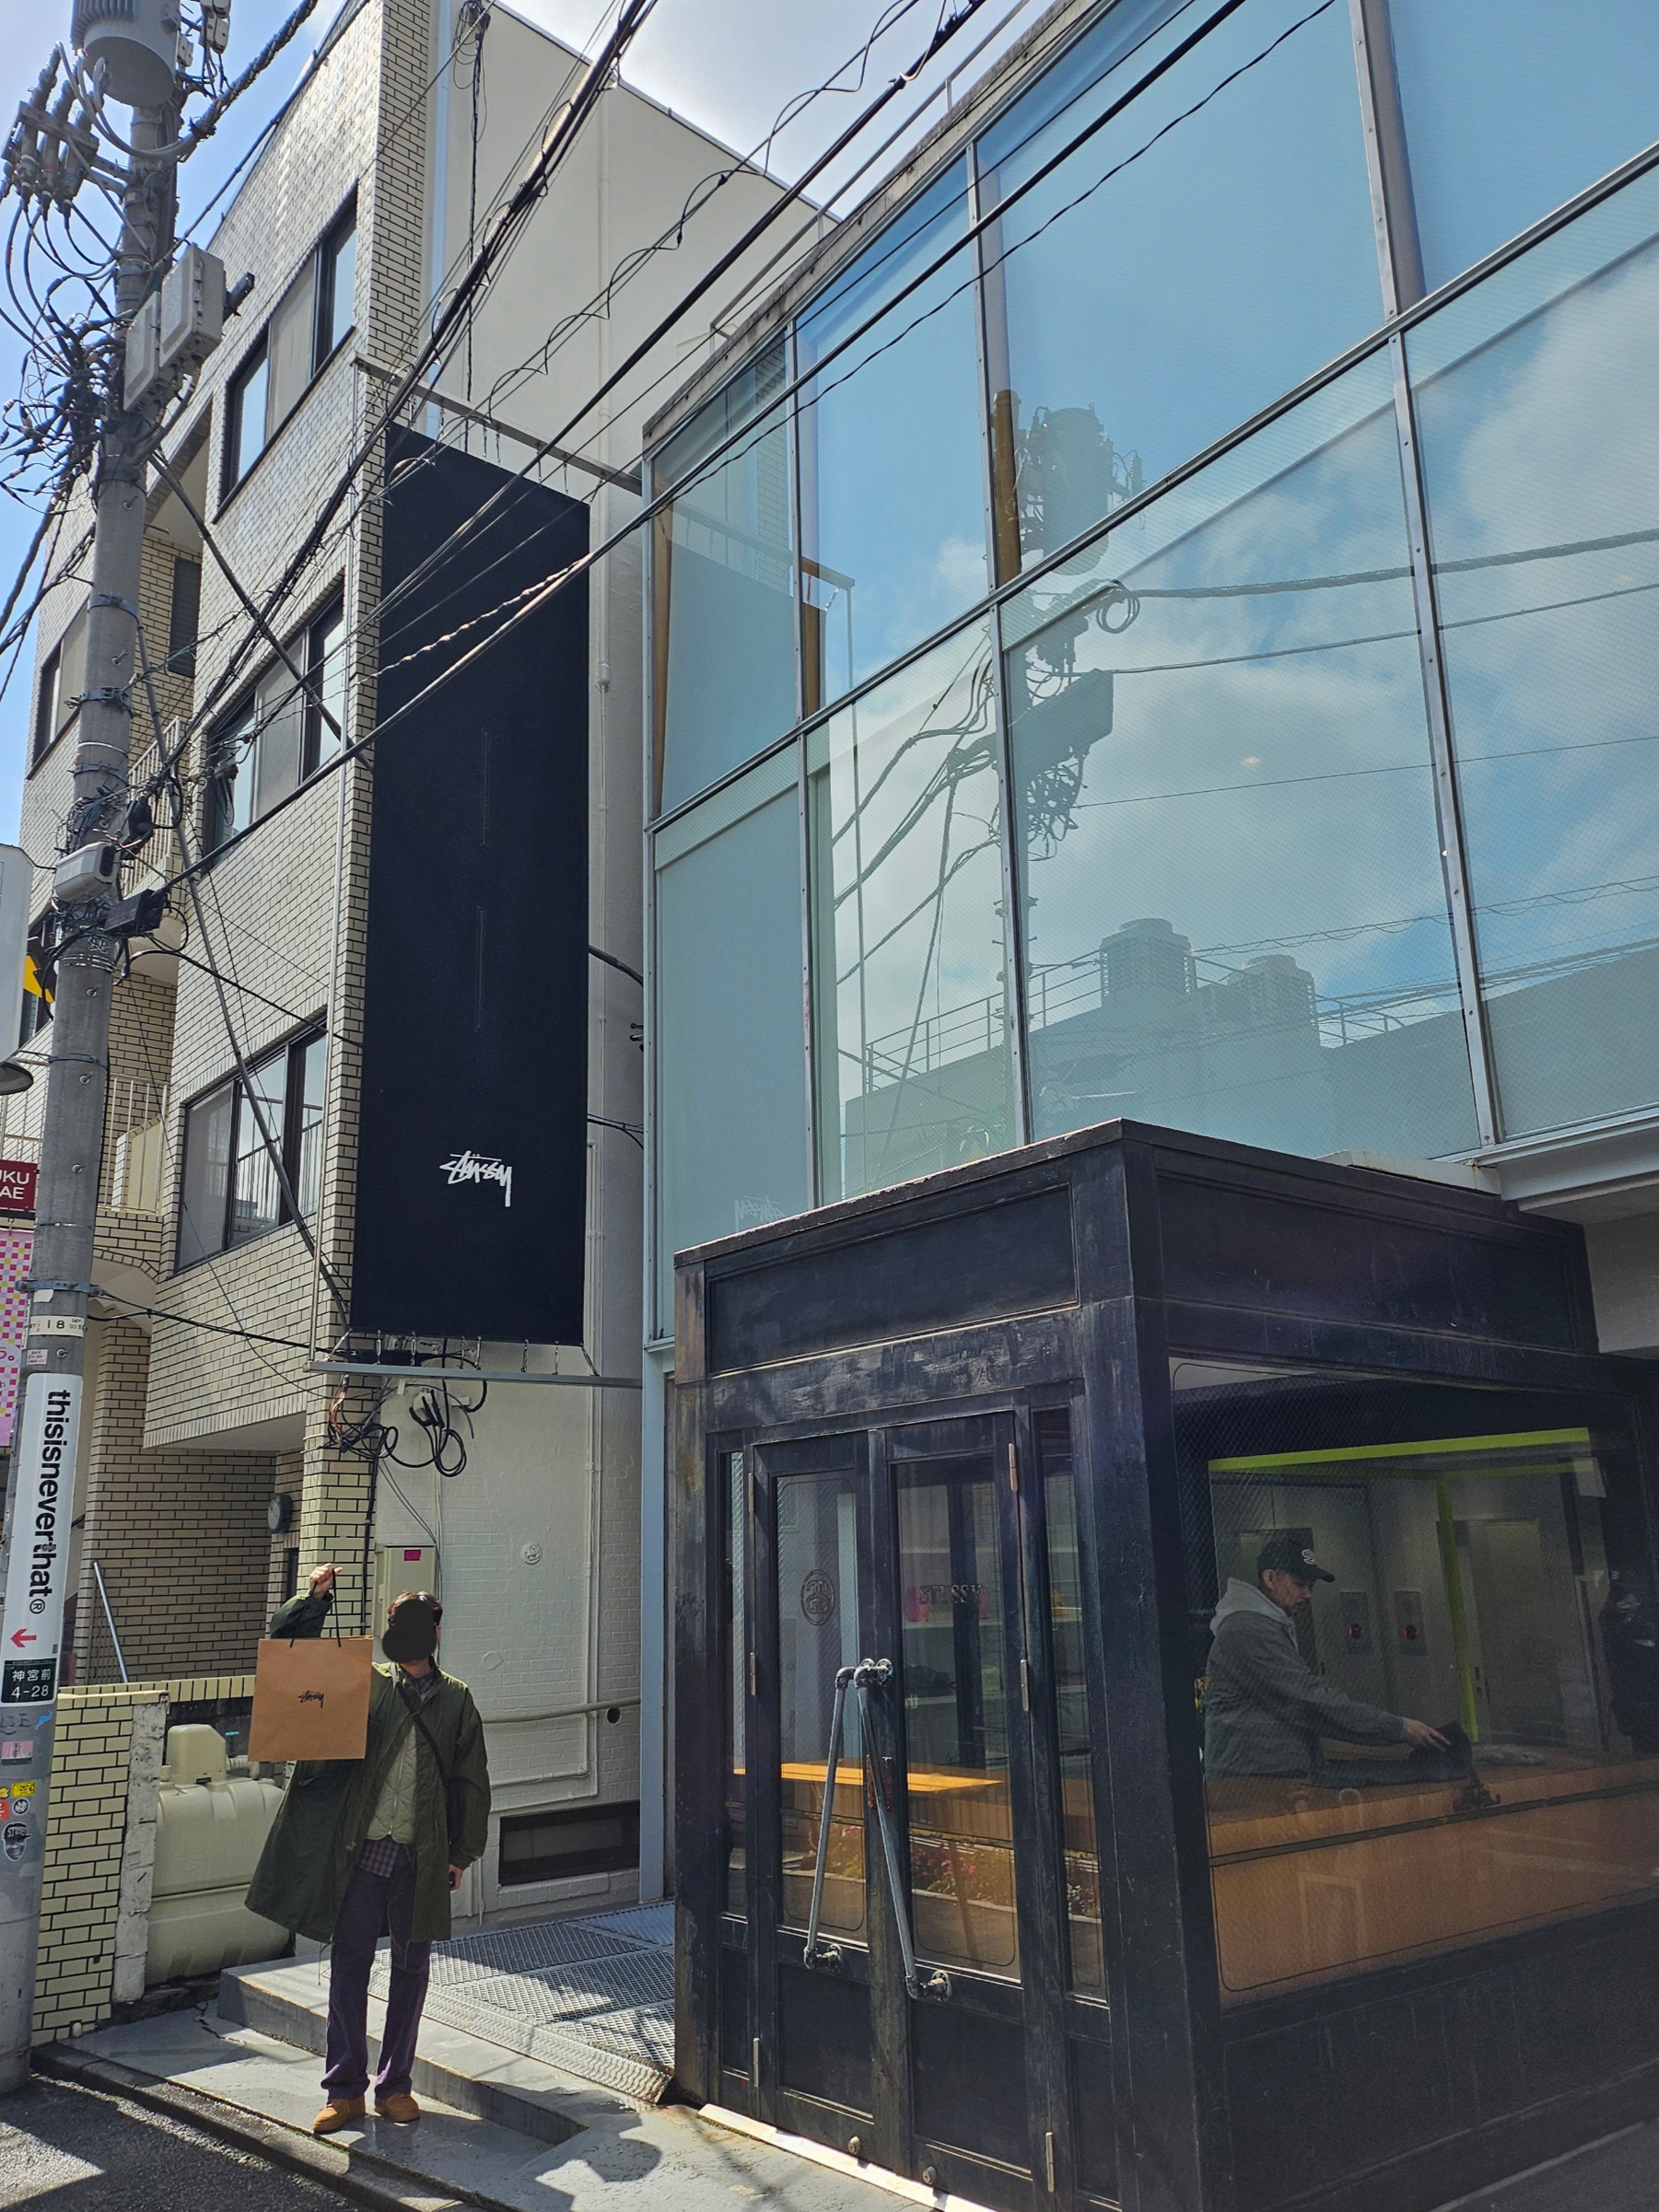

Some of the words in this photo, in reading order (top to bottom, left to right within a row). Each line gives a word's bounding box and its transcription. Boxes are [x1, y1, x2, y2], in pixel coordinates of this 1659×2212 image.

[12, 1668, 52, 1682] 神宮前
[11, 1684, 49, 1699] 4-28
